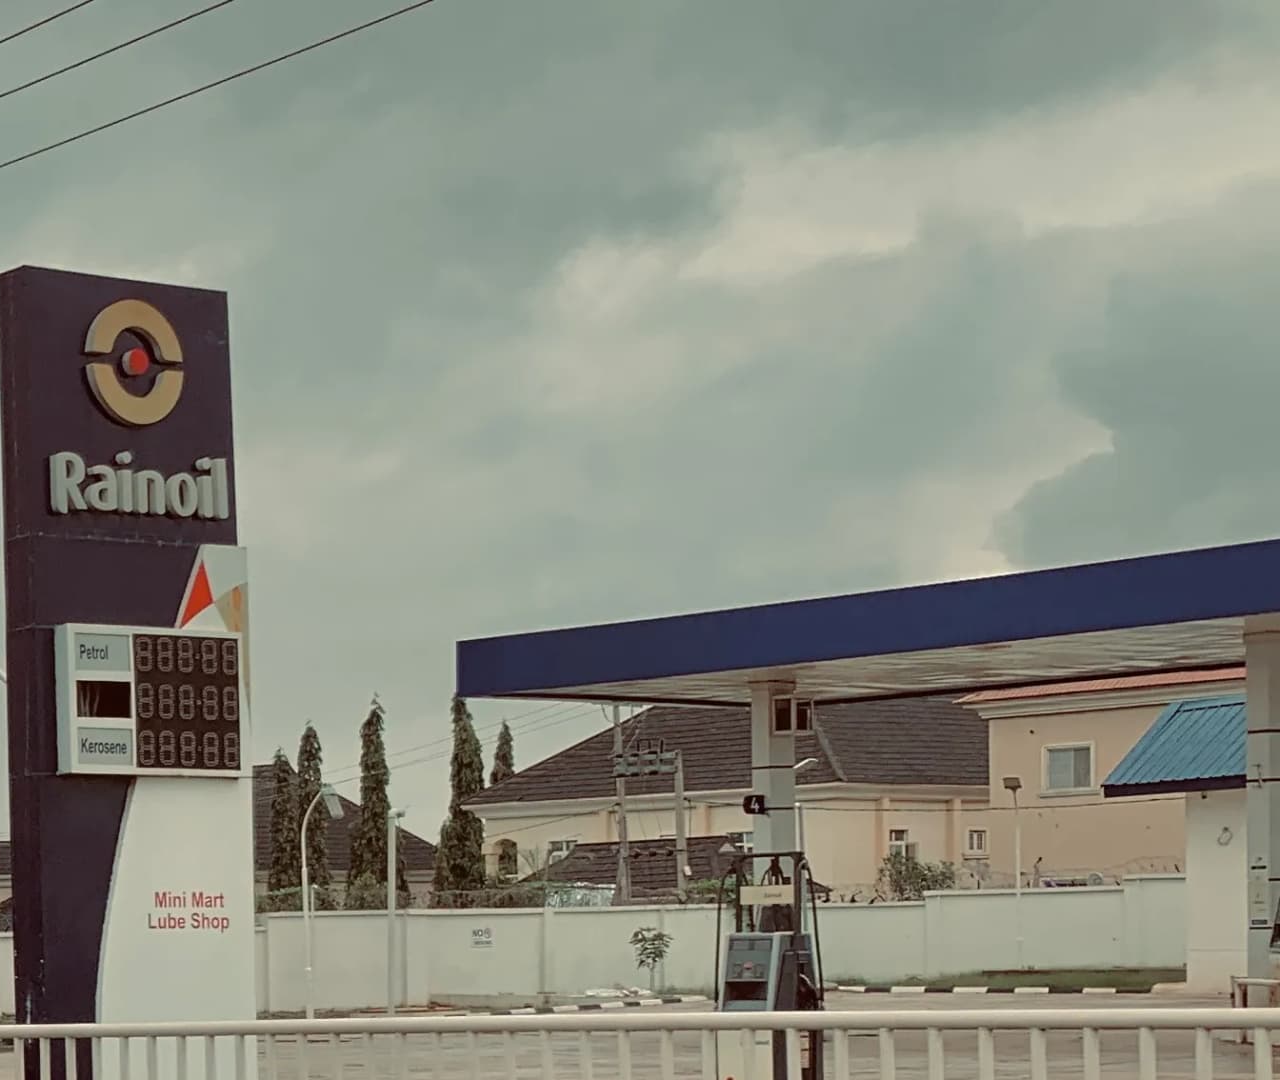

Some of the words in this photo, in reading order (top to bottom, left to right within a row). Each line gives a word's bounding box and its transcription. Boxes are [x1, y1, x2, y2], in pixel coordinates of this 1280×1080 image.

[49, 451, 229, 520] Rainoil
[79, 644, 109, 661] Petrol
[80, 737, 128, 755] Kerosene
[750, 797, 759, 813] 4
[154, 891, 187, 909] Mini
[191, 891, 225, 909] Mart
[147, 912, 187, 930] Lube
[190, 912, 230, 933] Shop
